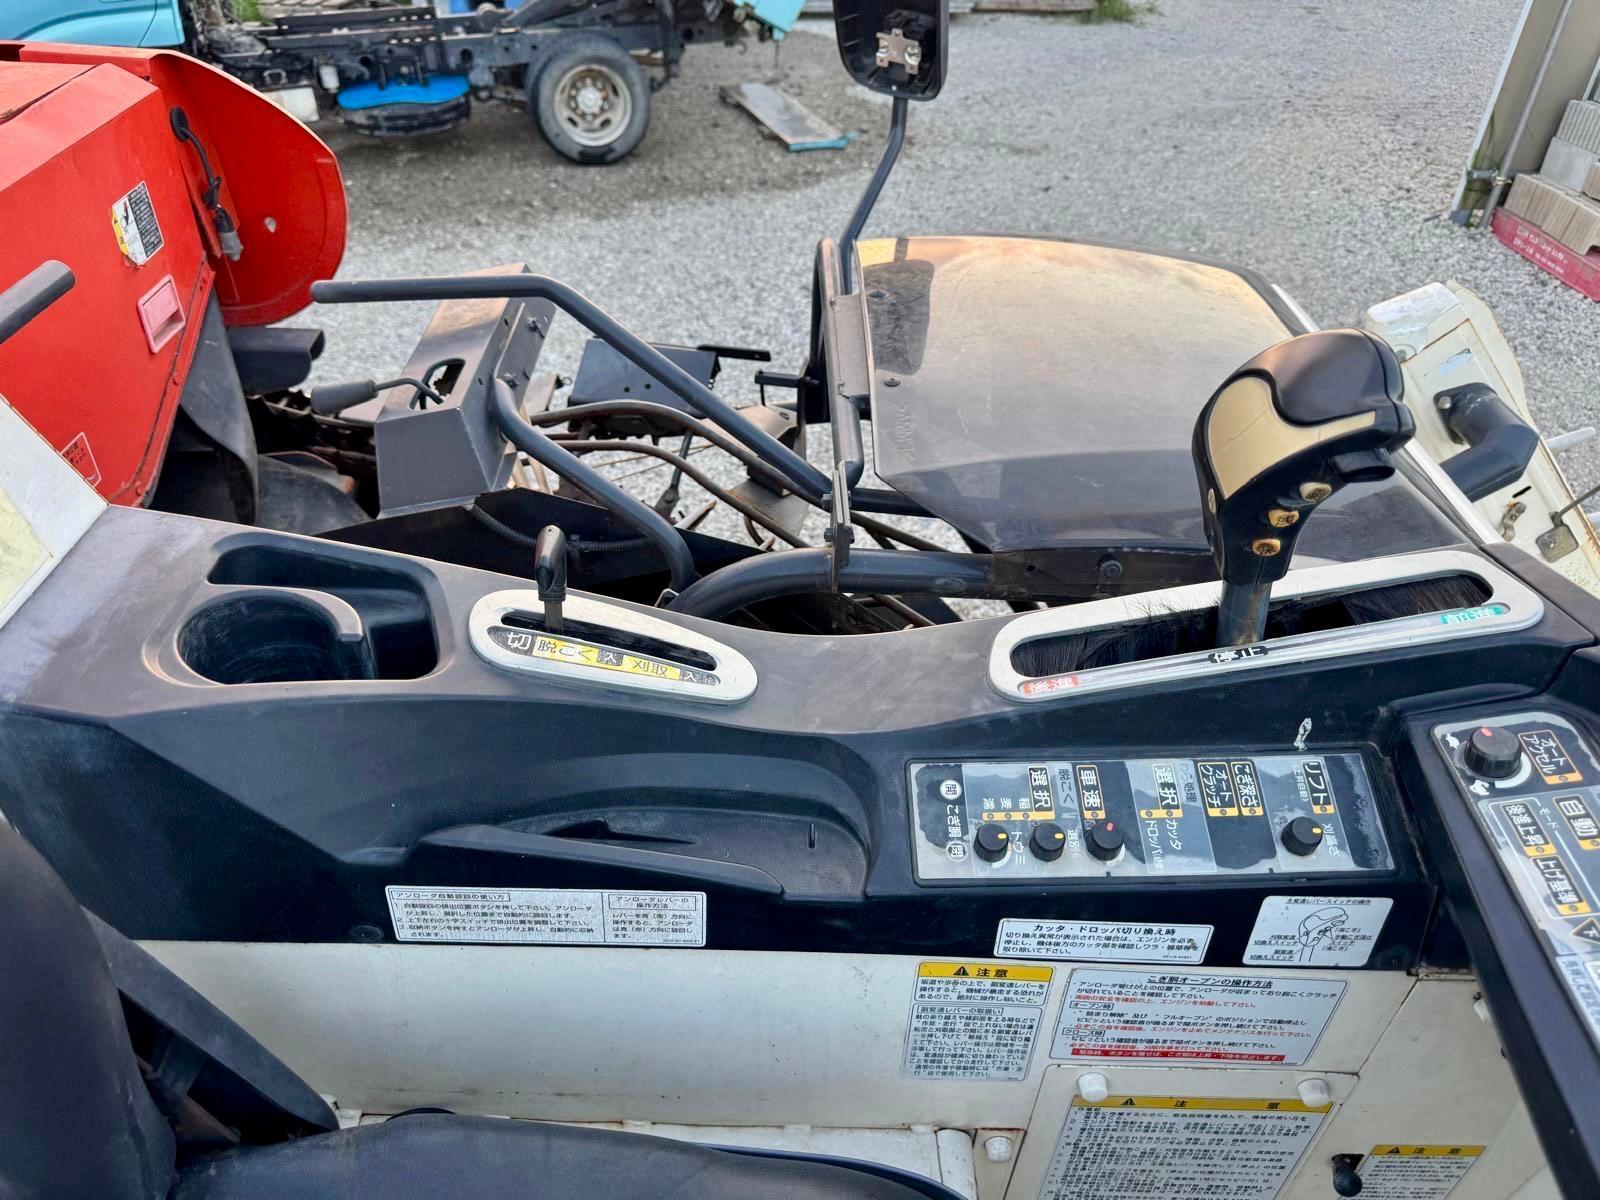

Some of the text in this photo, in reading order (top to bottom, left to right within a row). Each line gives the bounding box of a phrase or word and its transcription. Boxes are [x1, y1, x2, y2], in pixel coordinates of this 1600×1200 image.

[507, 632, 697, 682] 切 脱こく 入 刈取 入
[1213, 647, 1265, 664] 停止
[1523, 735, 1556, 774] アクセル
[1541, 738, 1567, 766] オート
[944, 783, 960, 796] 開
[1030, 769, 1052, 808] 選択
[1057, 768, 1075, 804] 脱こく
[1079, 769, 1102, 809] 車速
[1154, 766, 1177, 806] 選択
[1200, 765, 1222, 807] クラッチ
[1216, 769, 1233, 801] オート
[1234, 764, 1259, 807] こぎ深さ
[1306, 761, 1330, 804] リフト
[946, 804, 963, 838] こぎ胴
[1166, 818, 1183, 851] カッタ
[1506, 804, 1545, 846] 後進上昇
[1539, 807, 1560, 830] モード
[1559, 800, 1599, 837] 自動
[1011, 831, 1026, 866] トウミ
[1322, 822, 1342, 857] 刈高さ
[1536, 858, 1580, 904] 上げ基準
[1033, 923, 1177, 937] カッタ・ドロッパ切り換え時
[1002, 945, 1072, 955] 取り除いて下さい。
[976, 967, 1009, 978] 注意
[1146, 974, 1274, 988] こぎ胴オープンの操作方法
